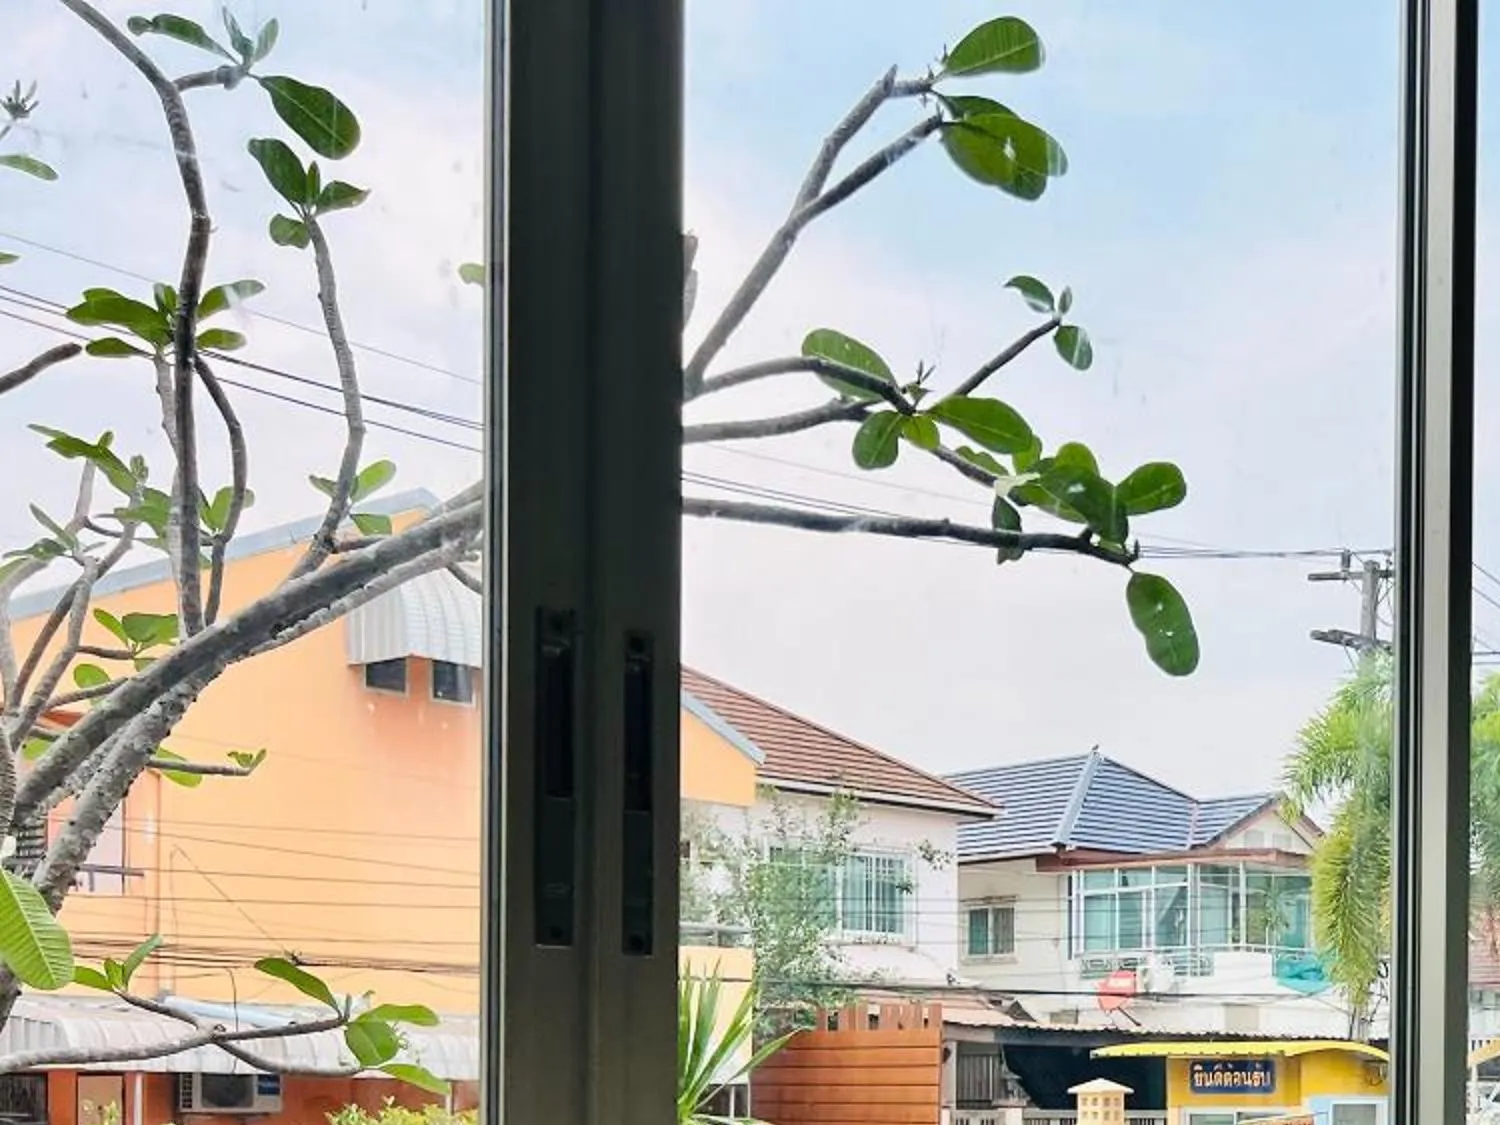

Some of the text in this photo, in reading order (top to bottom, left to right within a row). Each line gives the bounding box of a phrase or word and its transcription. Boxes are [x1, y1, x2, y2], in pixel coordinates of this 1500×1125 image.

[1194, 1062, 1271, 1088] ยินดีต้อนรับ
